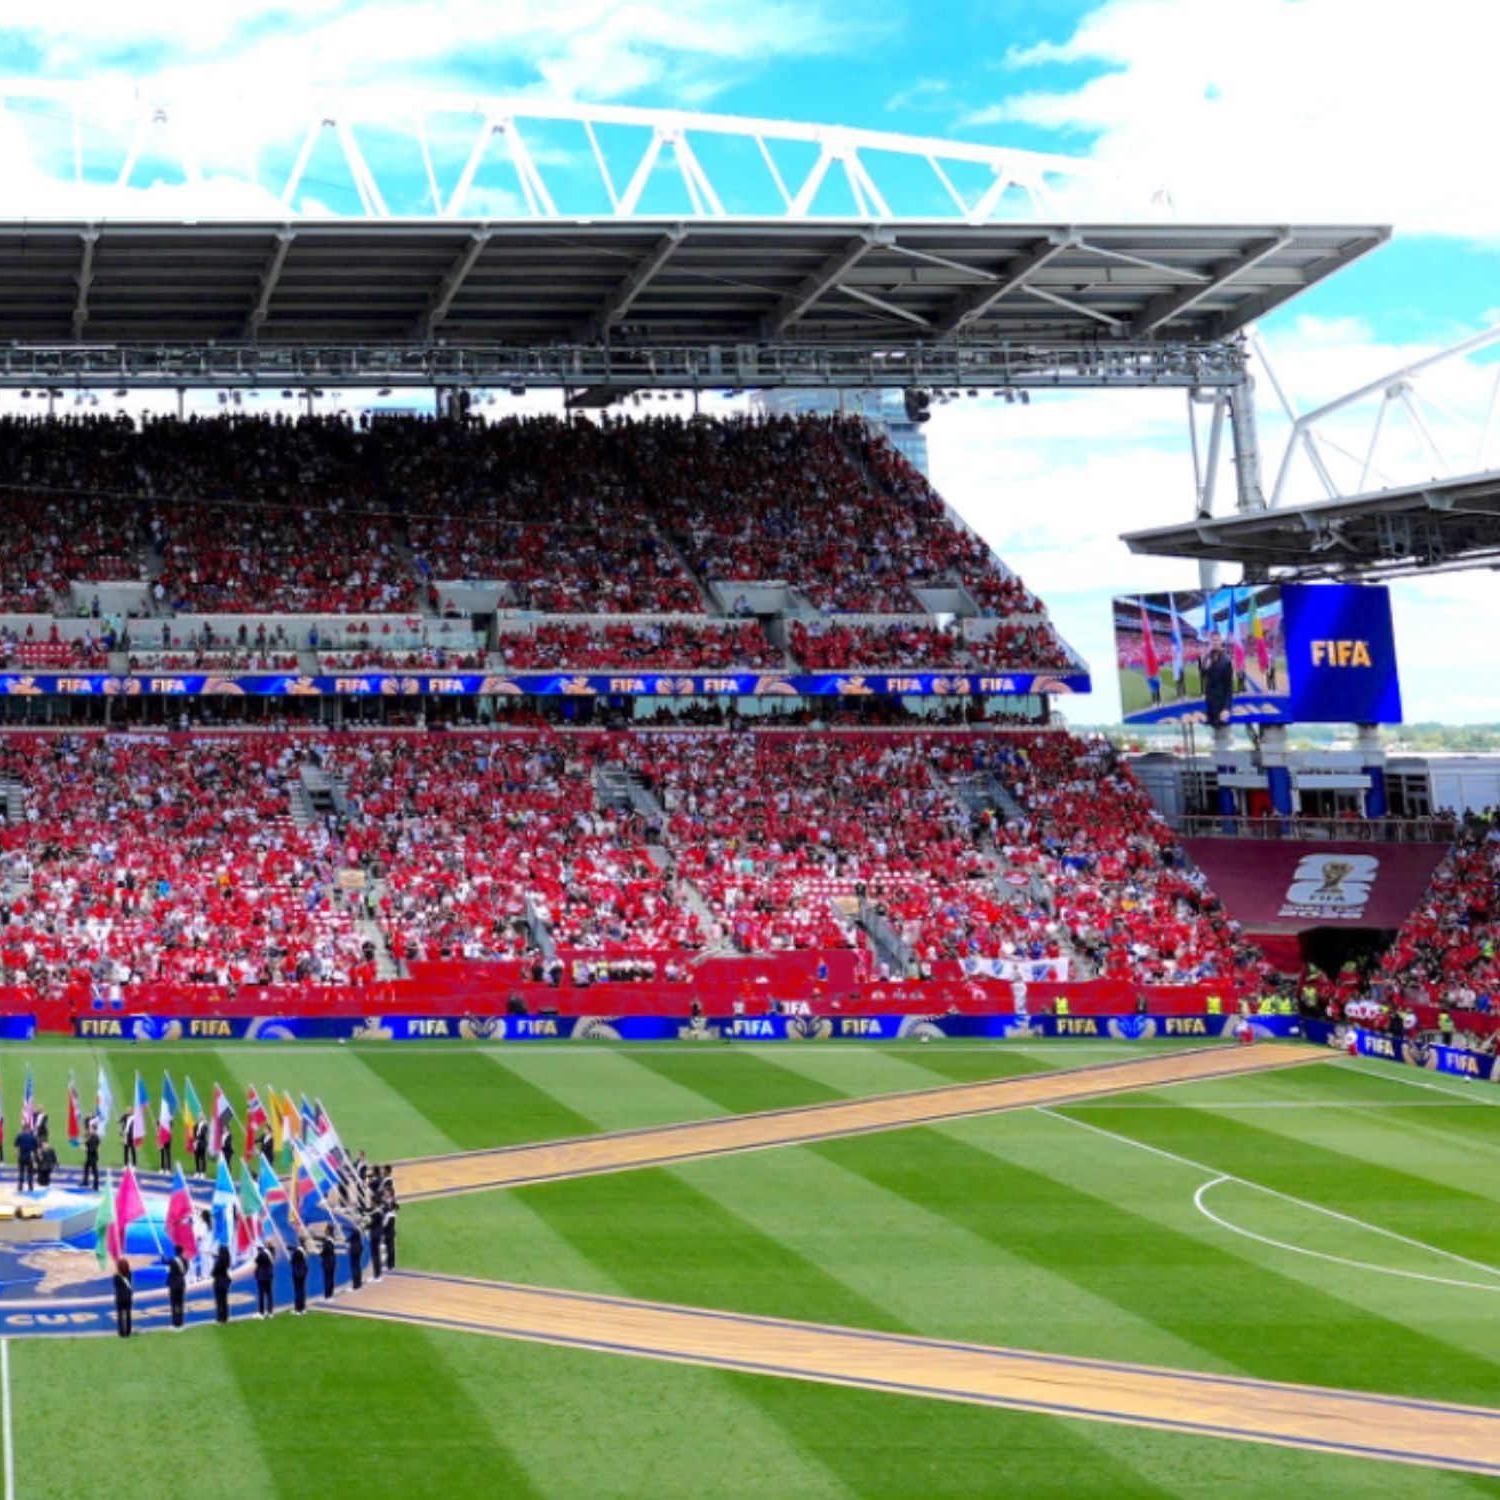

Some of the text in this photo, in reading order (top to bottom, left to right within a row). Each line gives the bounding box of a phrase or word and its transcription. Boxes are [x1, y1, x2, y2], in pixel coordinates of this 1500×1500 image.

[1311, 641, 1371, 667] FIFA
[56, 678, 92, 692] FIFA
[150, 678, 186, 692] FIFA
[335, 678, 371, 692] FIFA
[429, 678, 464, 692] FIFA
[610, 678, 646, 692] FIFA
[703, 678, 739, 692] FIFA
[886, 677, 922, 692] FIFA
[979, 677, 1015, 691] FIFA
[1309, 894, 1346, 902] FIFA
[81, 1019, 122, 1035] FIFA
[190, 1019, 231, 1035] FIFA
[409, 1019, 448, 1035] FIFA
[518, 1019, 557, 1034] FIFA
[733, 1020, 774, 1035] FIFA
[841, 1018, 881, 1034] FIFA
[1056, 1018, 1097, 1034] FIFA
[1165, 1018, 1206, 1033] FIFA
[1364, 1035, 1396, 1057] FIFA
[1444, 1052, 1480, 1074] FIFA
[5, 1312, 100, 1326] CUP
